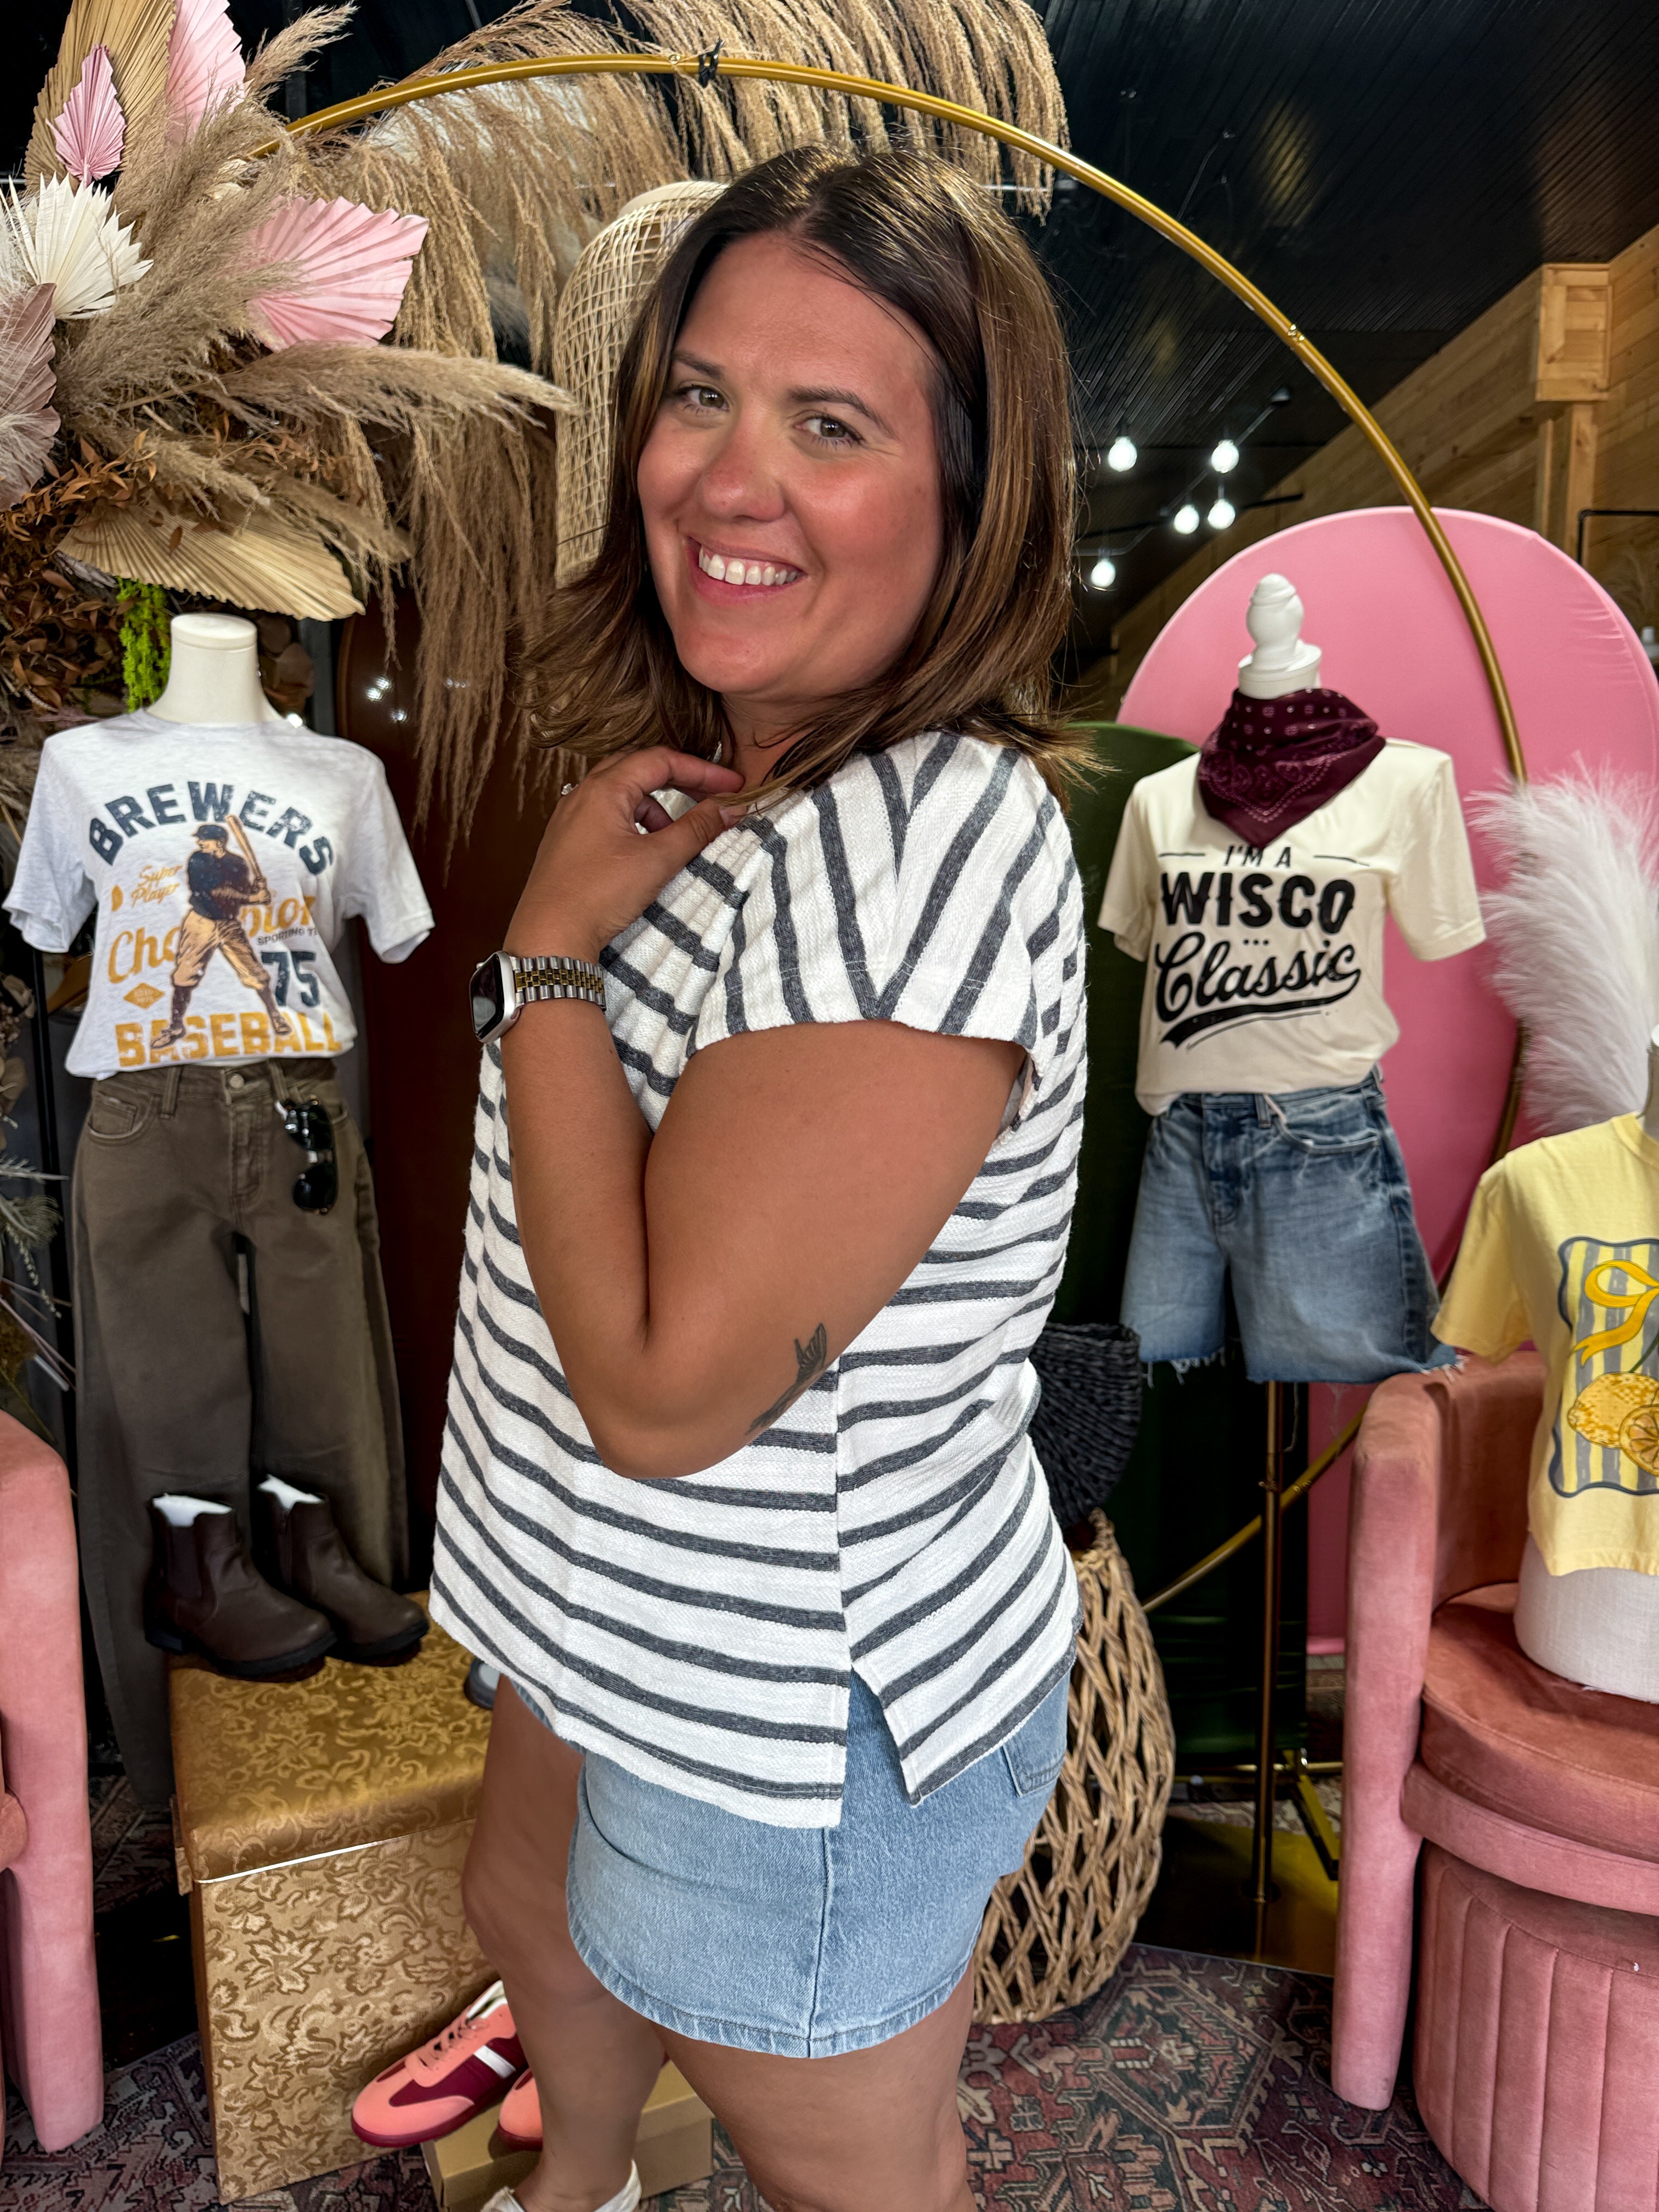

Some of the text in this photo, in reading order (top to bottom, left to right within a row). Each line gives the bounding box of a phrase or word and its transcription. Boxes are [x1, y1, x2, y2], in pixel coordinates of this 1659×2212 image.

[89, 781, 334, 876] BREWERS
[138, 865, 183, 887] Super
[1223, 845, 1291, 868] I'M A
[130, 883, 180, 909] Player
[1161, 872, 1355, 934] WISCO
[257, 927, 305, 945] SPORTING
[261, 951, 320, 1007] 75
[1155, 932, 1361, 1022] Classic
